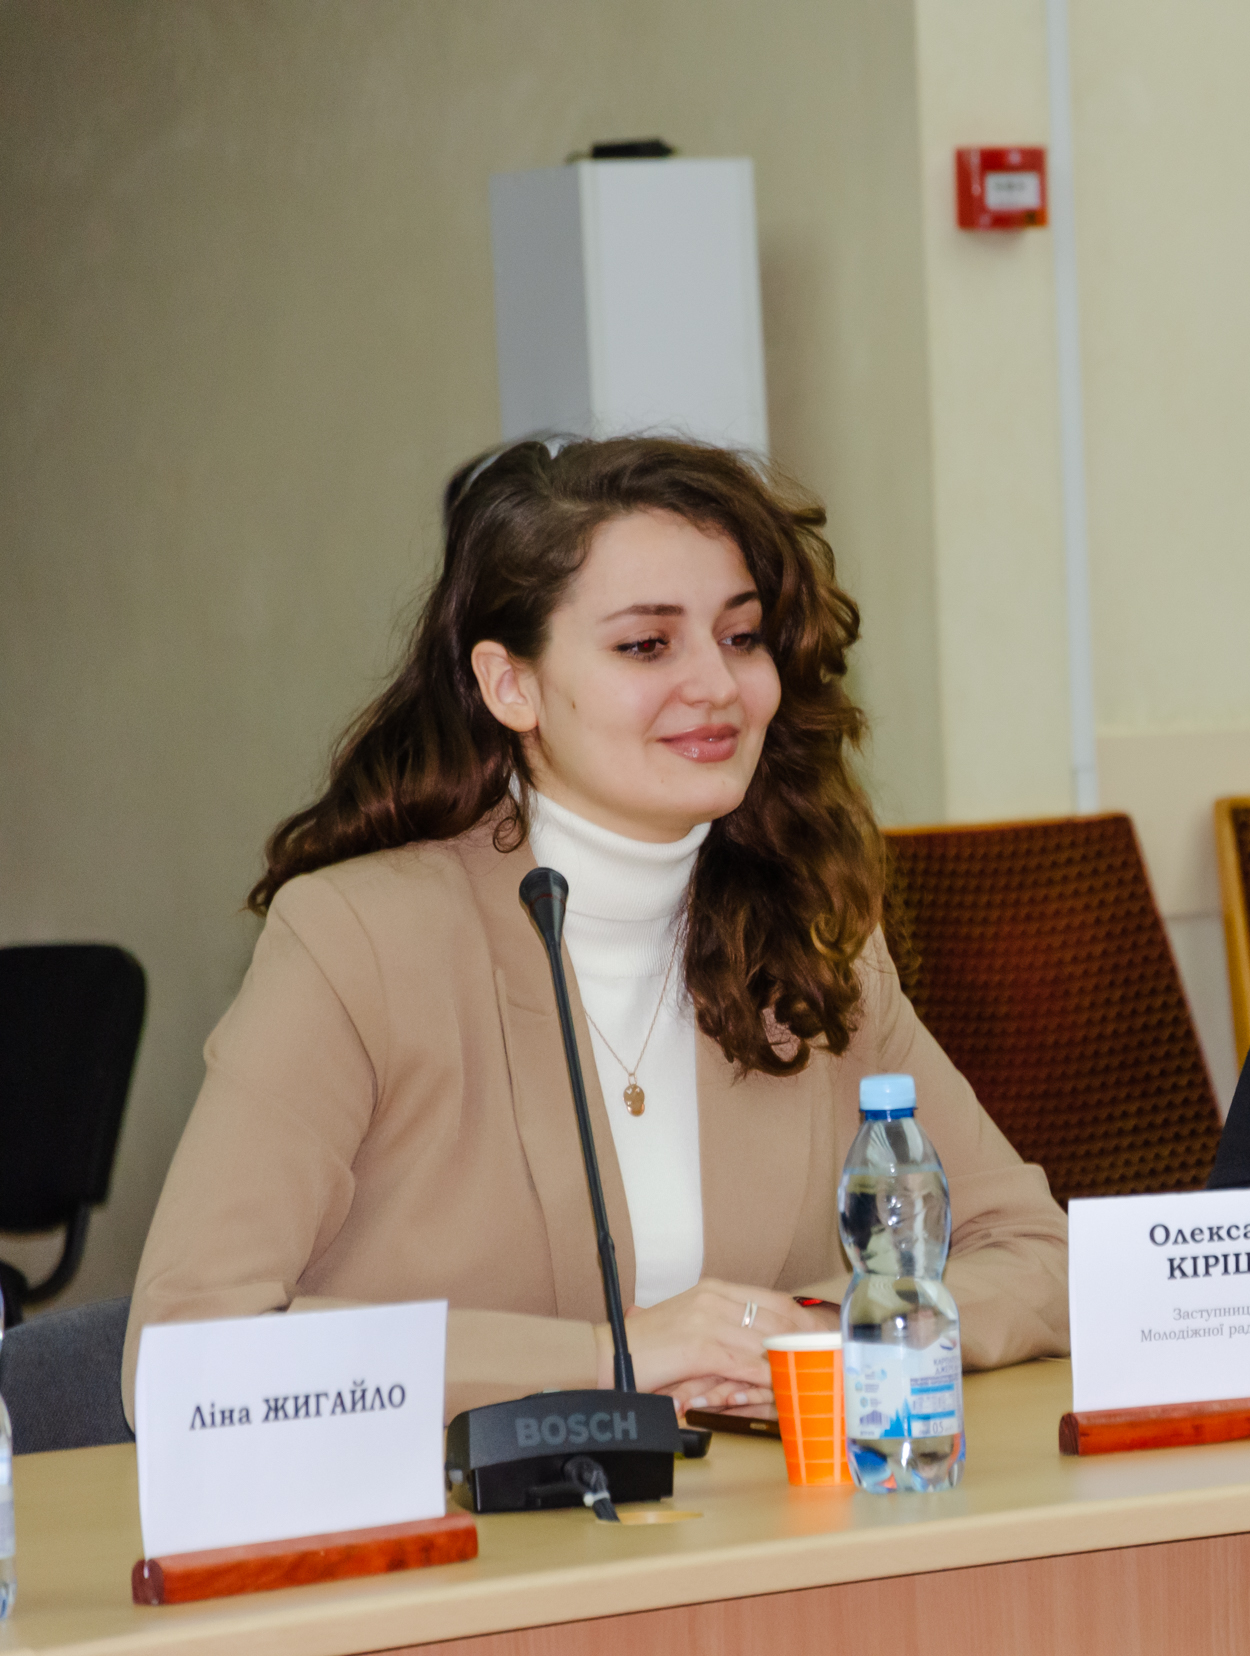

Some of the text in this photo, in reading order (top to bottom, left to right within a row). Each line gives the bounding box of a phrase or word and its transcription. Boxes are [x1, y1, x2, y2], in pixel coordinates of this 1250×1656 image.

[1140, 1324, 1225, 1342] Молодіжної
[189, 1379, 406, 1431] Ліна ЖИГАЙЛО
[515, 1411, 638, 1447] BOSCH
